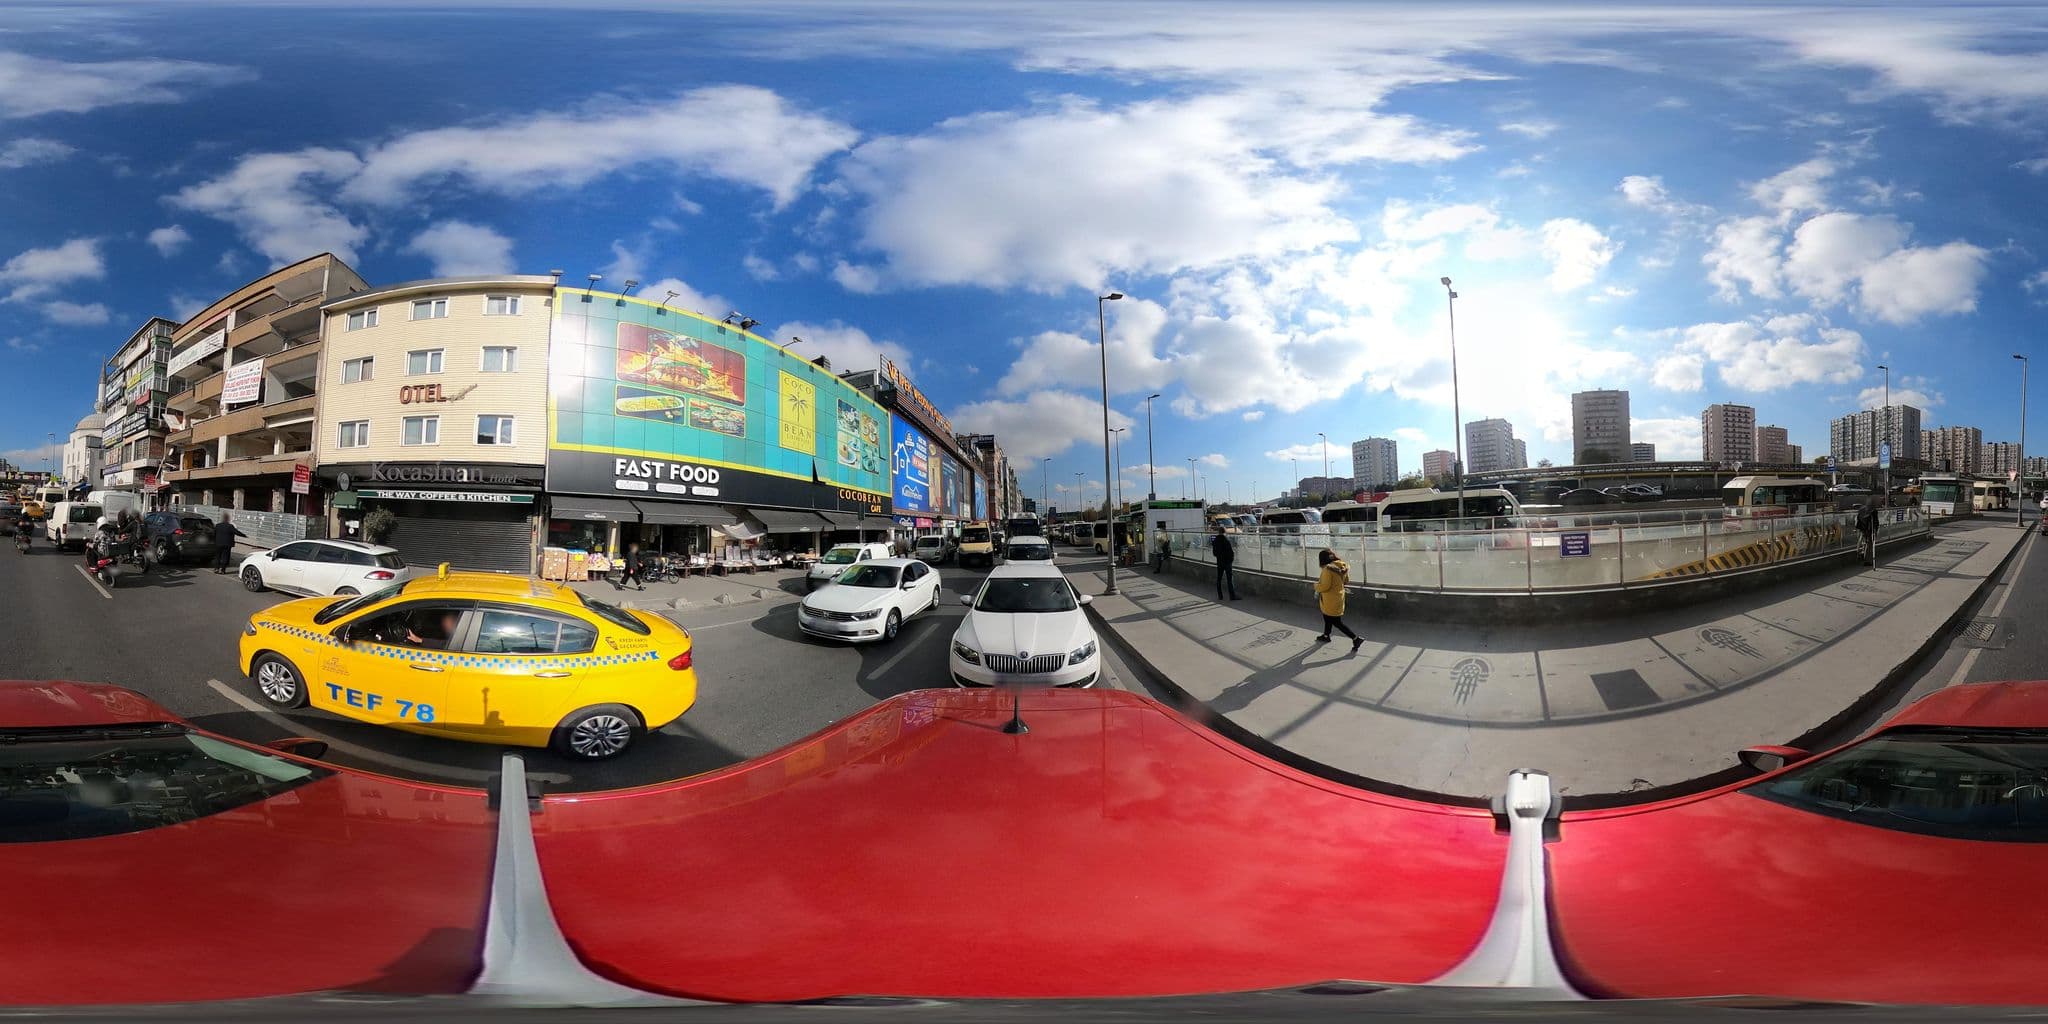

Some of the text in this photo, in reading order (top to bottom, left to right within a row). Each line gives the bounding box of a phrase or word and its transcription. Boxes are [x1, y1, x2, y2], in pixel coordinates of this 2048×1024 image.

[399, 383, 447, 405] OTEL
[783, 377, 812, 395] COCO
[784, 423, 812, 440] BEAN
[370, 461, 484, 483] Kocasinan
[615, 458, 720, 484] FAST FOOD
[376, 490, 512, 502] THE WAY COFFEE & KITCHEN
[839, 488, 882, 505] COCOBEAN
[870, 504, 882, 513] CAFE
[325, 681, 436, 723] TEF 78
